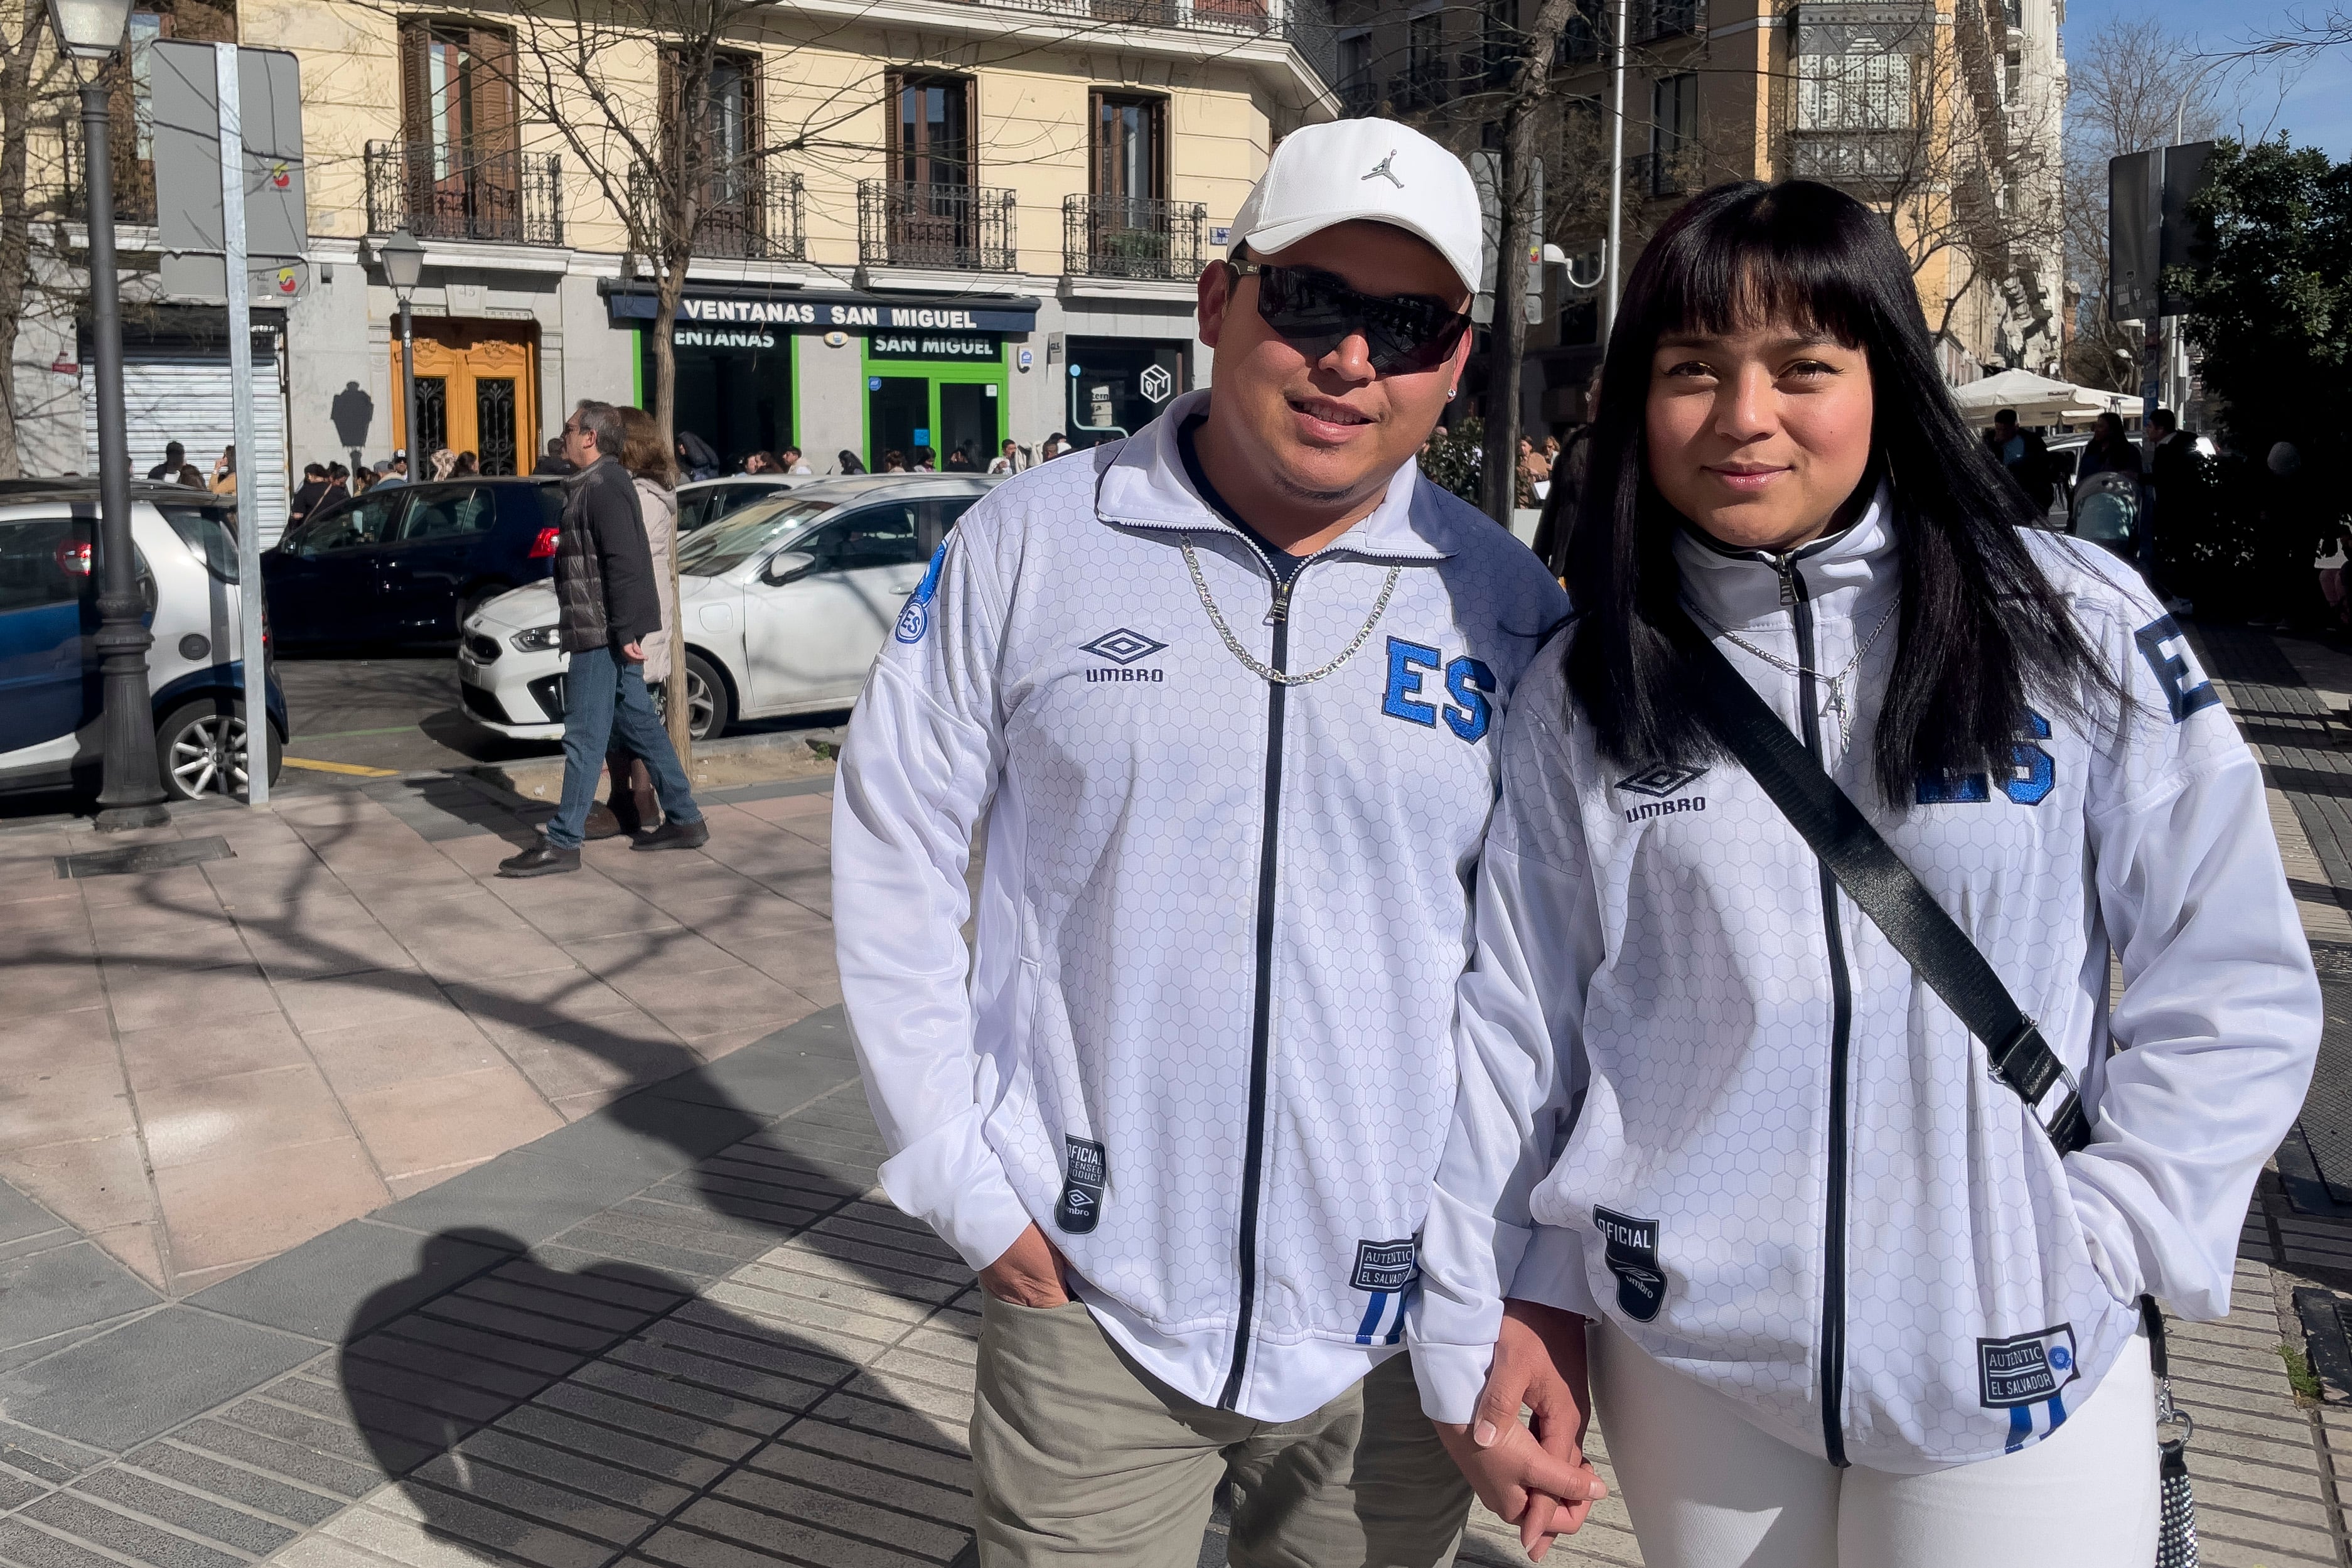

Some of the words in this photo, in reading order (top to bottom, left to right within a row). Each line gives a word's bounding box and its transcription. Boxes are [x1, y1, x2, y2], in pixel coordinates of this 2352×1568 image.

[682, 299, 815, 323] VENTANAS
[830, 306, 878, 326] SAN
[891, 308, 977, 329] MIGUEL
[674, 328, 775, 348] ENTANAS
[875, 335, 917, 353] SAN
[921, 337, 993, 355] MIGUEL
[900, 609, 921, 634] ES
[1086, 669, 1164, 682] UMBRO
[1380, 635, 1497, 746] ES
[1625, 796, 1706, 824] UMBRO
[1066, 1206, 1090, 1216] mbro
[1598, 1218, 1651, 1248] OFICIAL
[1365, 1250, 1412, 1264] AUTENTIC
[1361, 1272, 1371, 1282] EL
[1626, 1275, 1654, 1299] umbro
[1989, 1346, 2043, 1367] AUTENTIC
[1991, 1381, 2004, 1395] EL
[2006, 1373, 2053, 1395] SALVADOR
